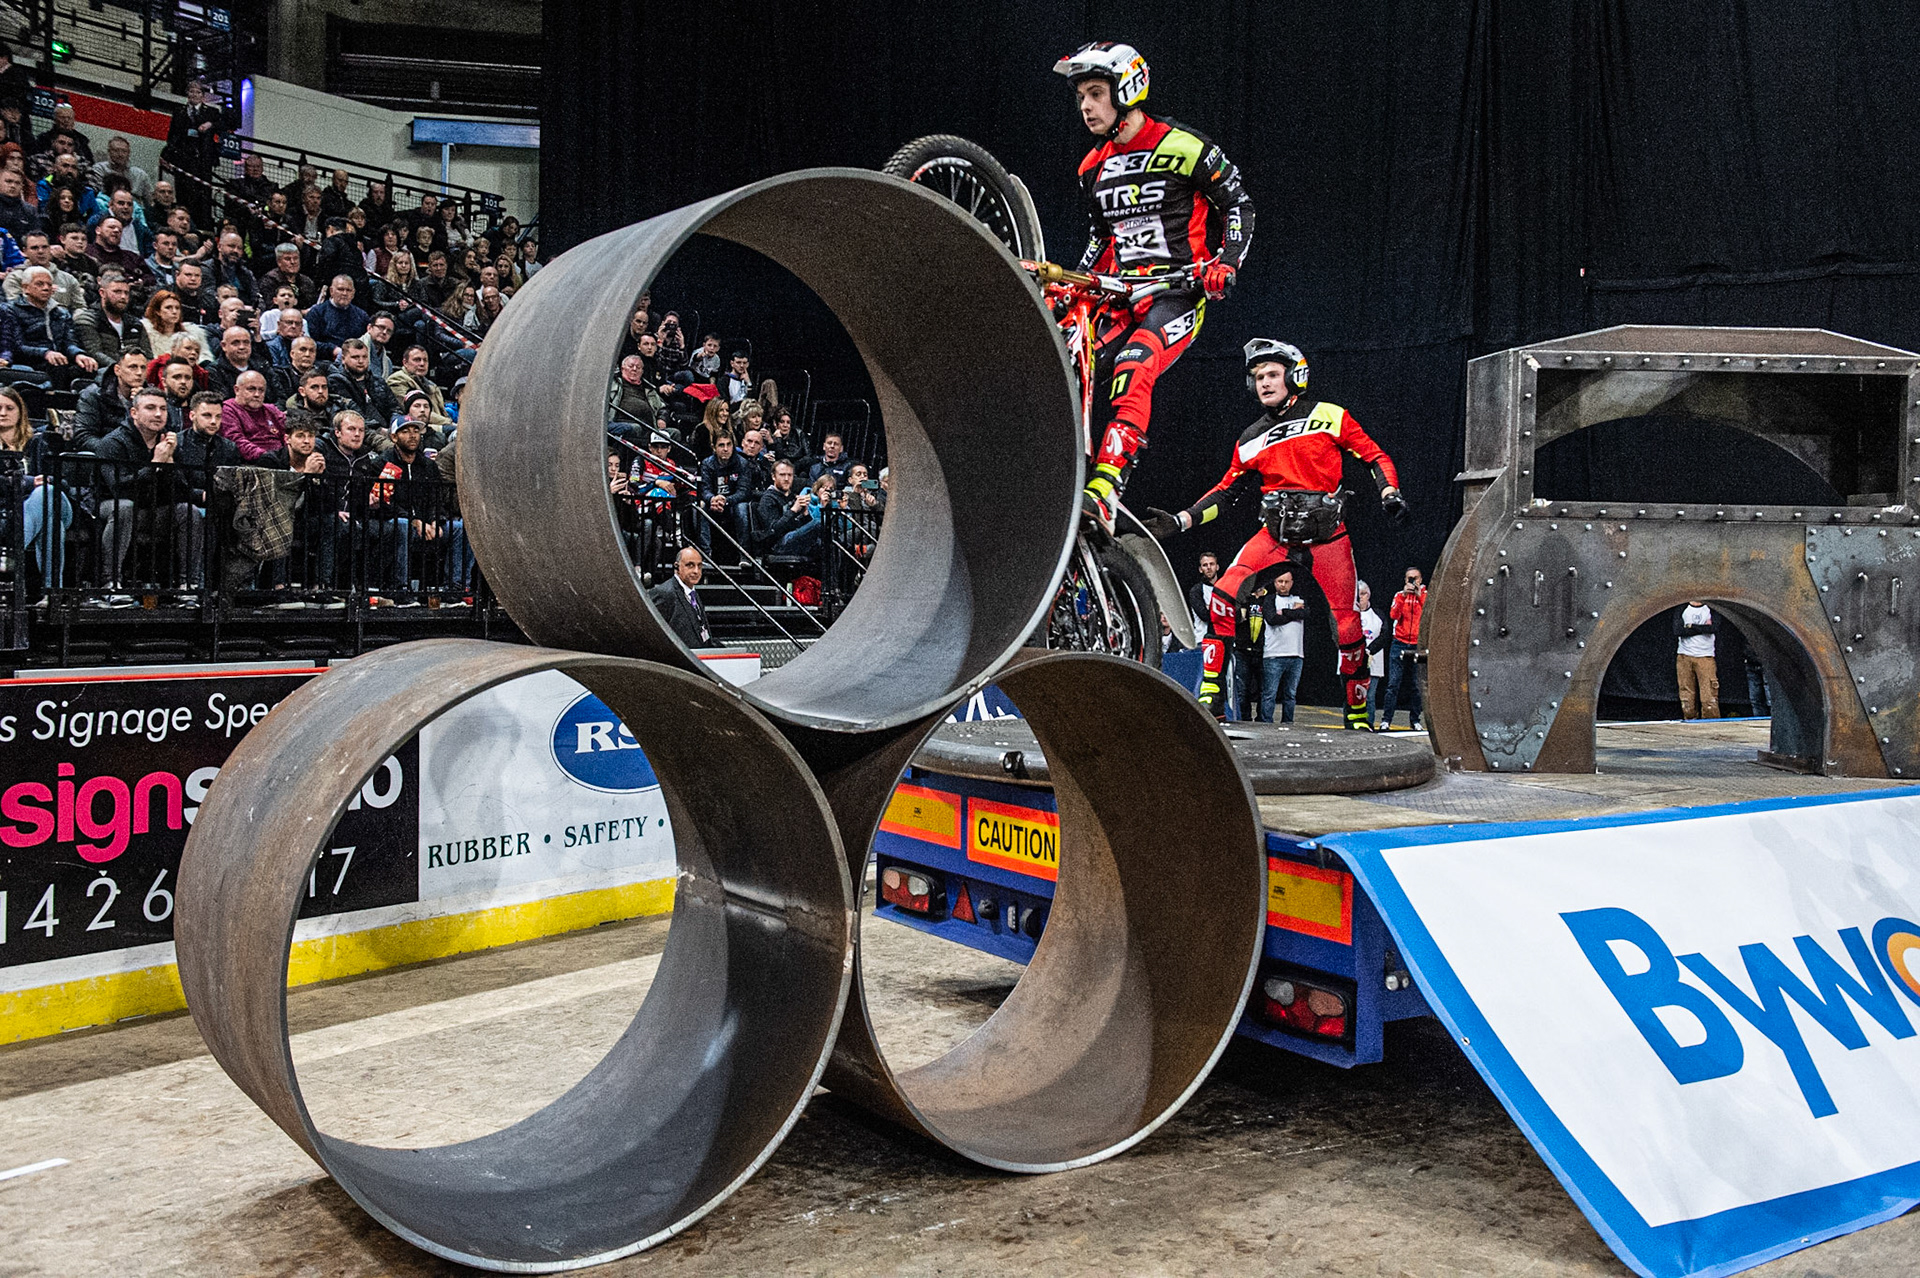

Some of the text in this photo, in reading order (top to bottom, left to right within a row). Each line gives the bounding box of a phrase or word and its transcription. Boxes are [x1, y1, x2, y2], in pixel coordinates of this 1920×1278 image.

[213, 12, 230, 24] 201
[34, 95, 56, 109] 102
[223, 138, 240, 150] 101
[484, 197, 498, 208] 101
[32, 699, 192, 747] Signage
[204, 692, 280, 738] Spe
[427, 816, 648, 868] RUBBER SAFETY
[978, 817, 1056, 862] CAUTION
